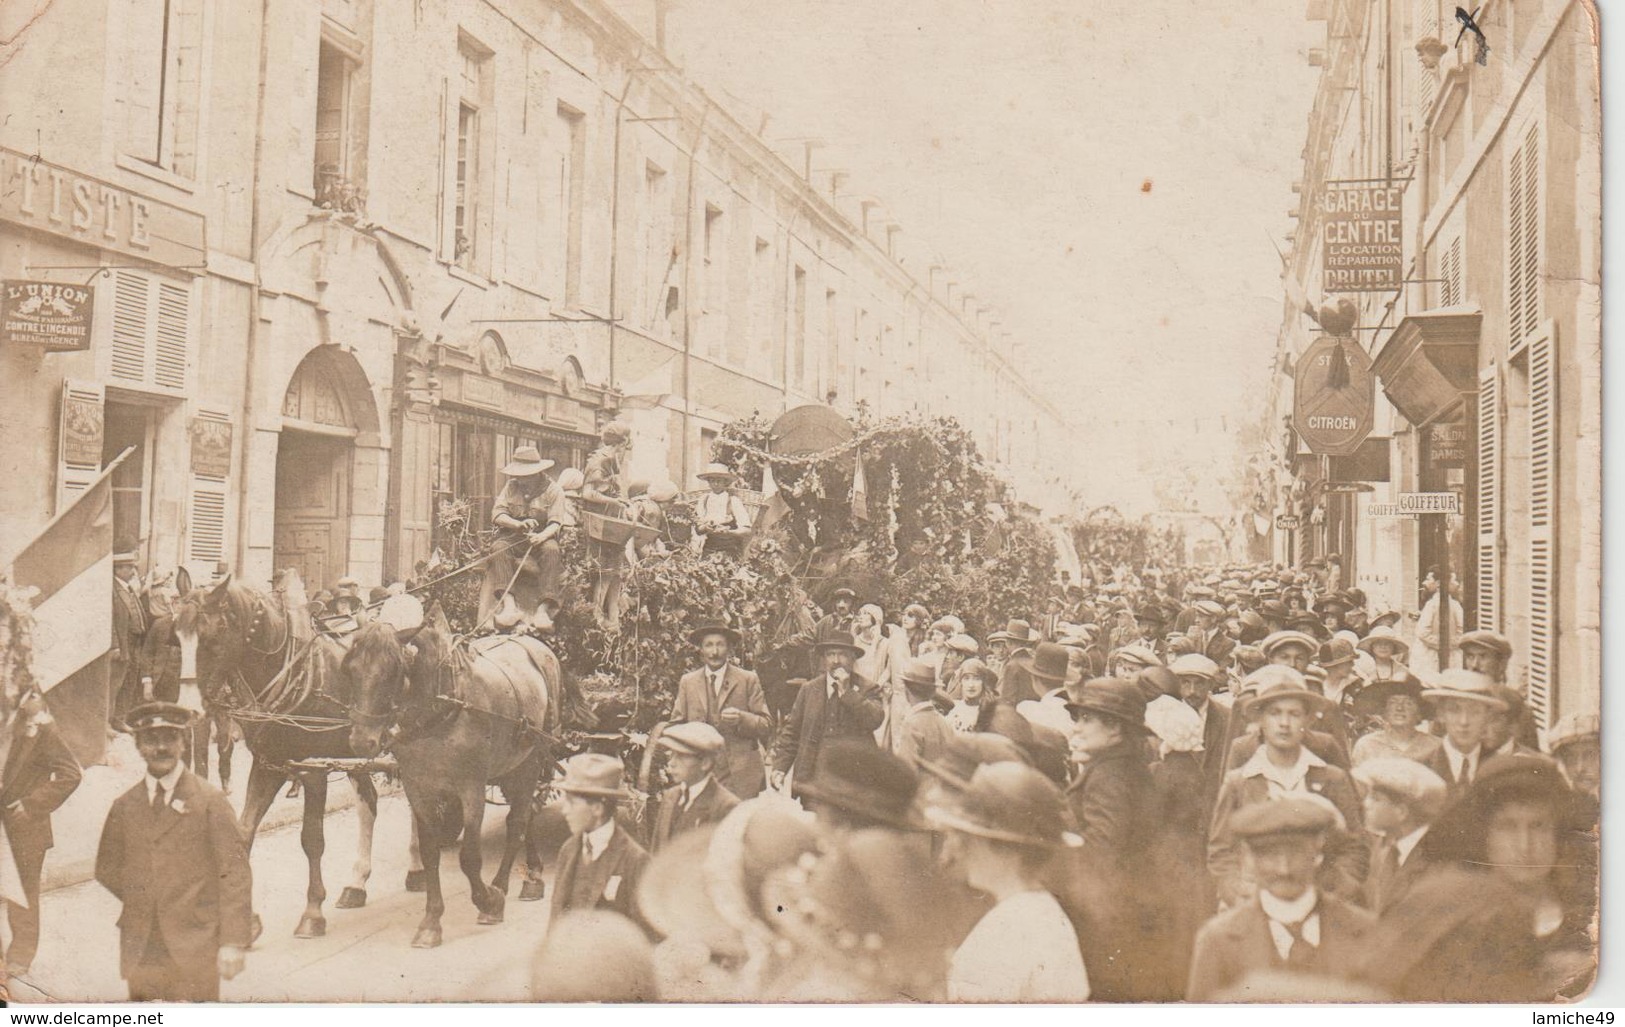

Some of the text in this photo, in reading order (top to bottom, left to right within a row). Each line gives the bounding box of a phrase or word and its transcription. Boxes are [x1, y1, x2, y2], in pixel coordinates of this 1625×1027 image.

[1324, 188, 1399, 213] GARAGE
[1353, 212, 1370, 220] DU
[1324, 219, 1399, 244] CENTRE
[1330, 245, 1401, 255] LOCATION
[1328, 254, 1401, 266] RÉPARATION
[8, 284, 88, 304] L'UNION
[5, 320, 87, 336] CONTRE L'INCENDIE
[1318, 355, 1352, 367] STK
[1308, 414, 1357, 430] CITROËN
[1431, 430, 1466, 441] SALON
[1431, 449, 1465, 460] DAMES
[1400, 495, 1456, 511] COIFFEUR
[1368, 504, 1399, 516] COIFFE
